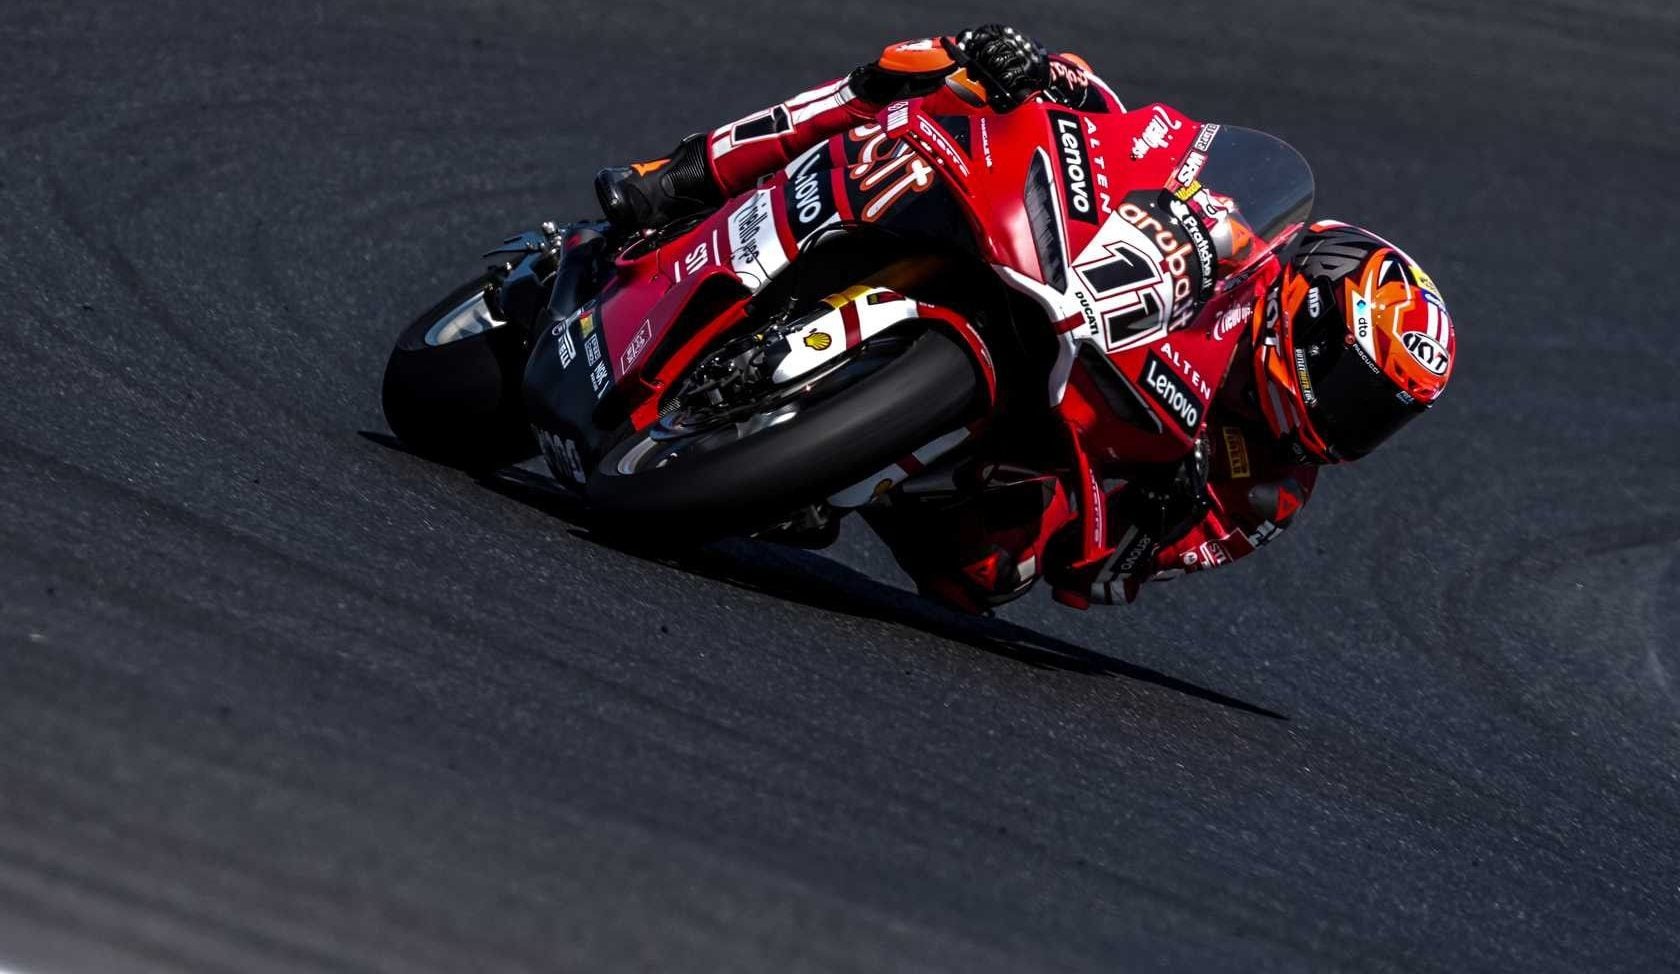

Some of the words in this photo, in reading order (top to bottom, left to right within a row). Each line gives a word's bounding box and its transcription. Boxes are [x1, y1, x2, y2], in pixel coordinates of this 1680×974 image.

[795, 153, 822, 223] Lnovo
[1057, 118, 1091, 214] Lenovo
[1083, 115, 1113, 215] ALTEN
[1117, 202, 1195, 332] aruba.it
[1074, 290, 1100, 336] DUCATI
[1358, 317, 1368, 338] dto
[1160, 341, 1211, 400] ALTEN
[1352, 343, 1380, 375] PASCUCCI
[1146, 360, 1198, 428] Lenovo
